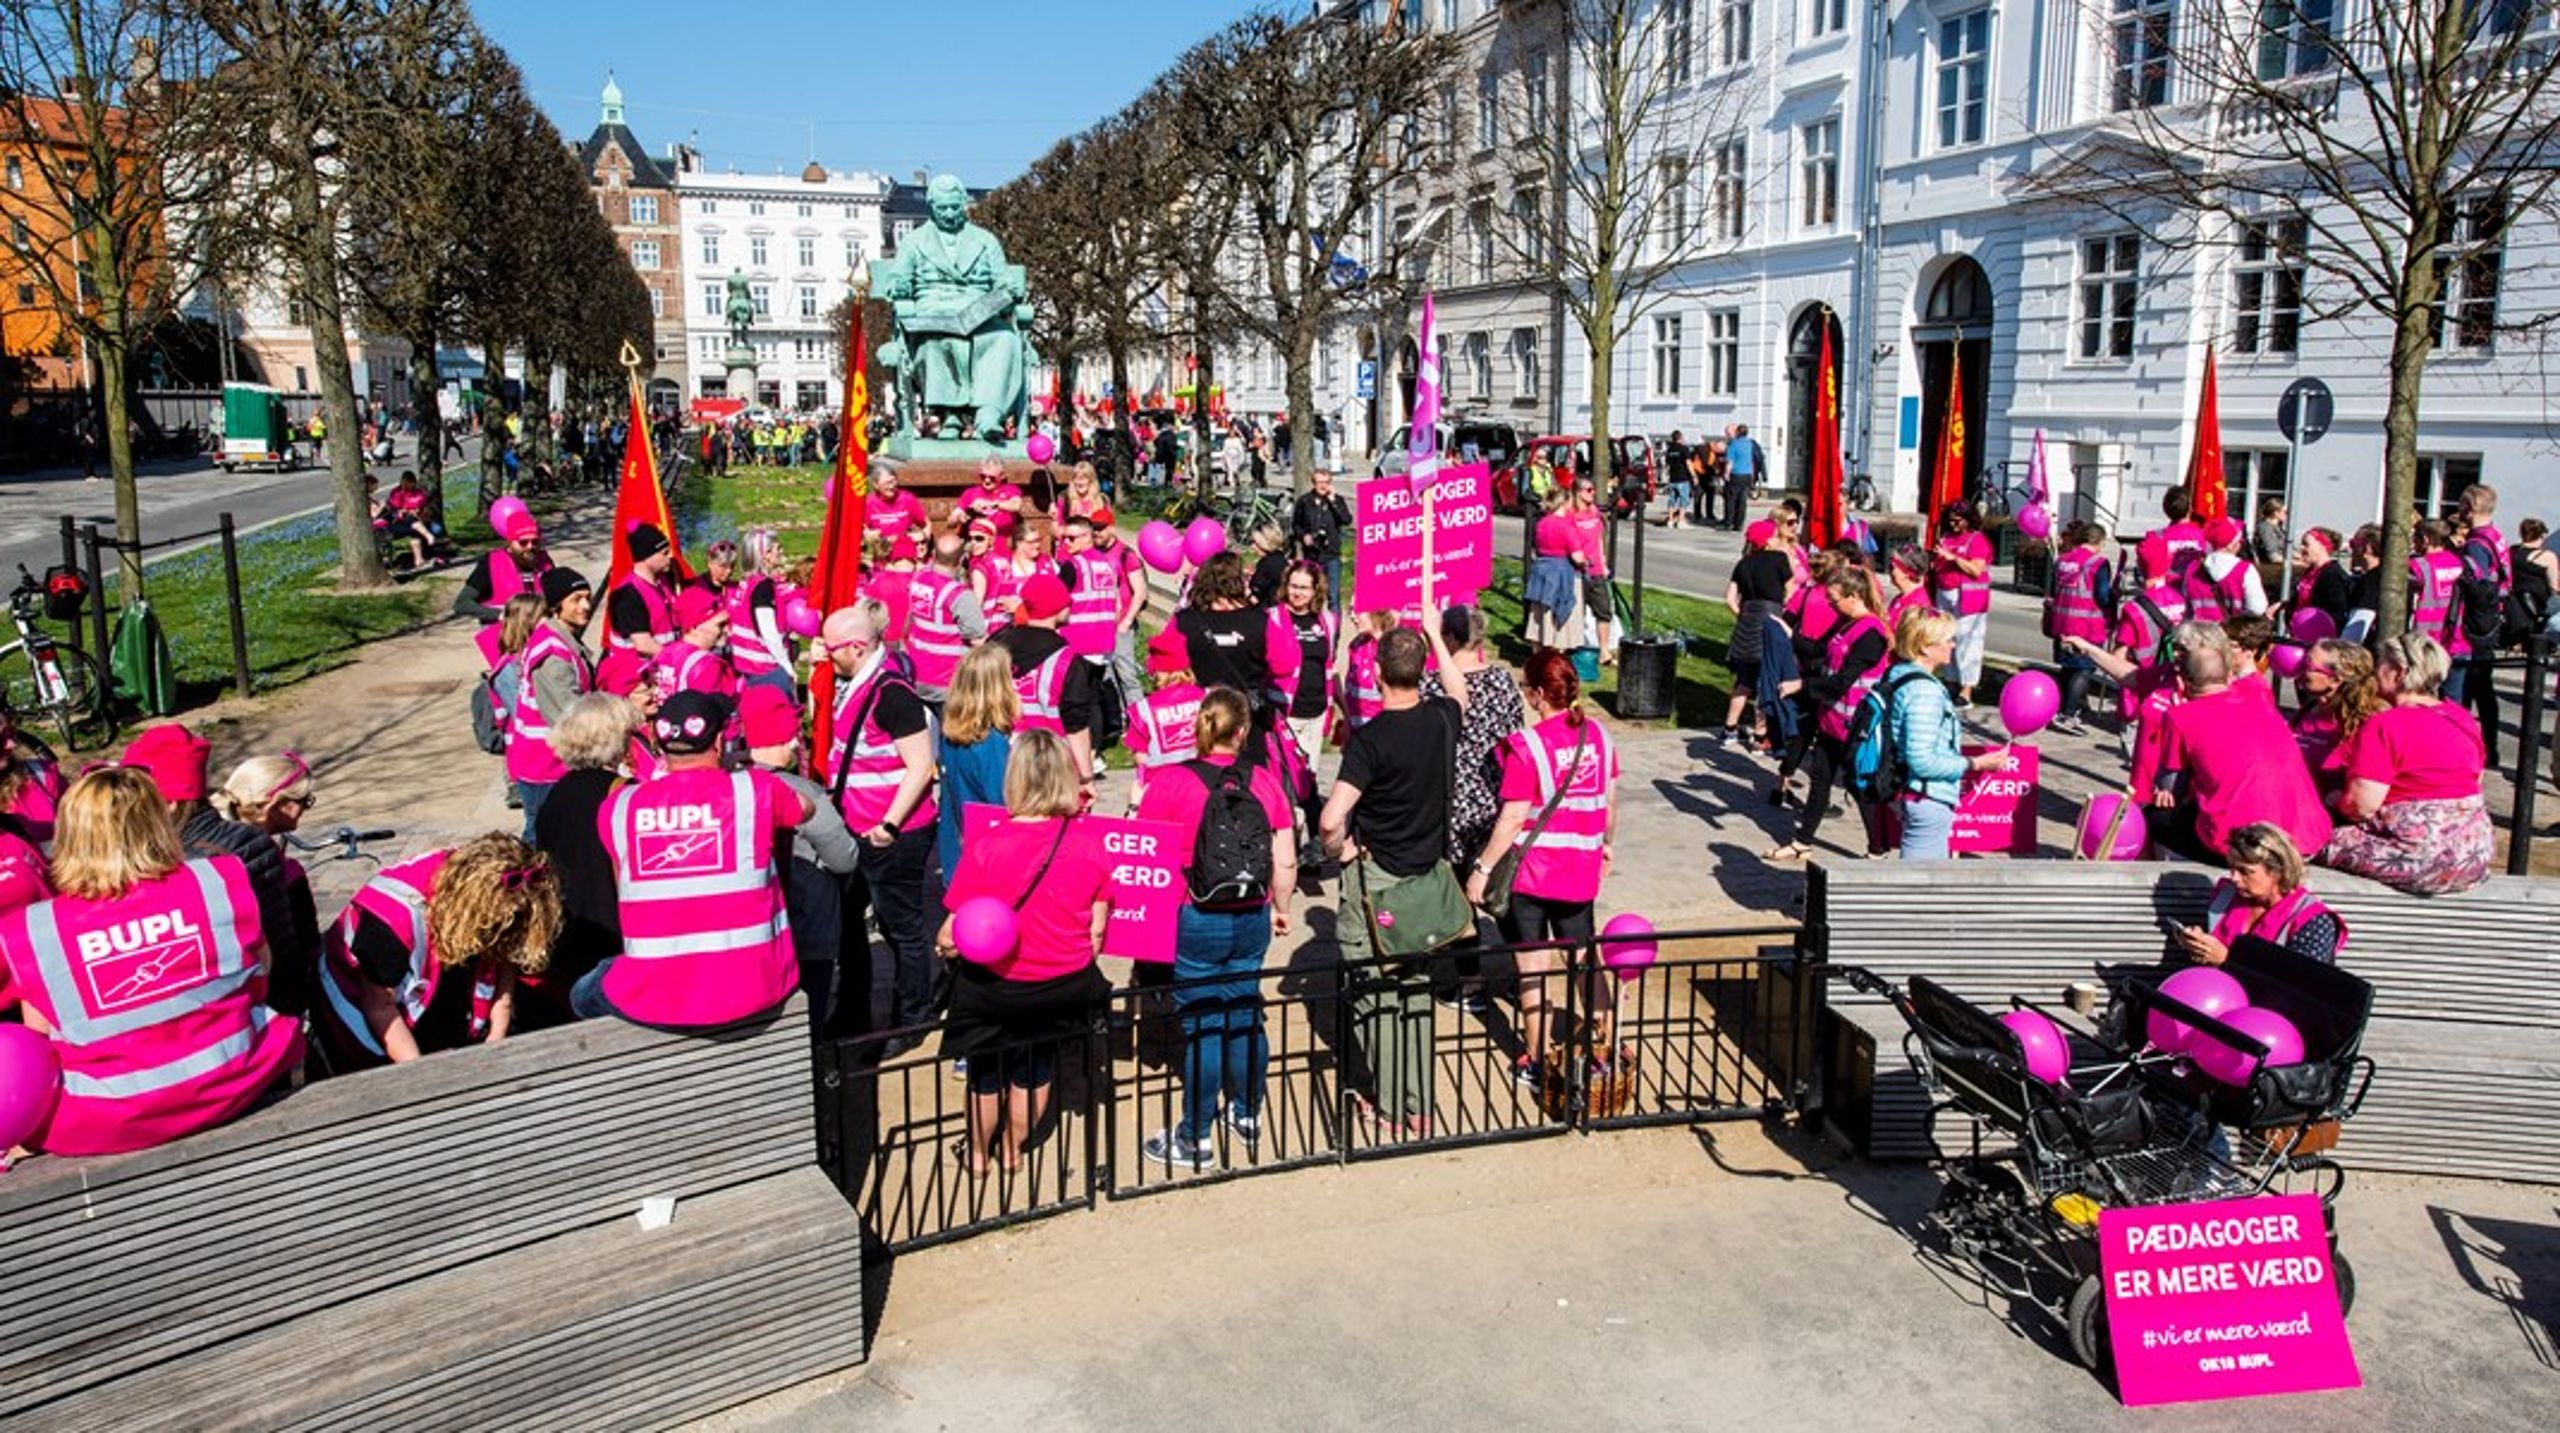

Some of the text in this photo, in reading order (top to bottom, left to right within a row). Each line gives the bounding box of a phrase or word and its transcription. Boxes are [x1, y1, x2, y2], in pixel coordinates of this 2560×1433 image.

[1373, 478, 1477, 513] PÆDOGER
[1363, 524, 1386, 544] ER
[1440, 504, 1487, 529] VÆRD
[636, 803, 721, 832] BUPL
[1110, 864, 1172, 889] ÆRD
[76, 908, 200, 963] BUPL
[2126, 1214, 2300, 1254] PÆDAGOGER
[2114, 1256, 2324, 1299] ER MERE VÆRD
